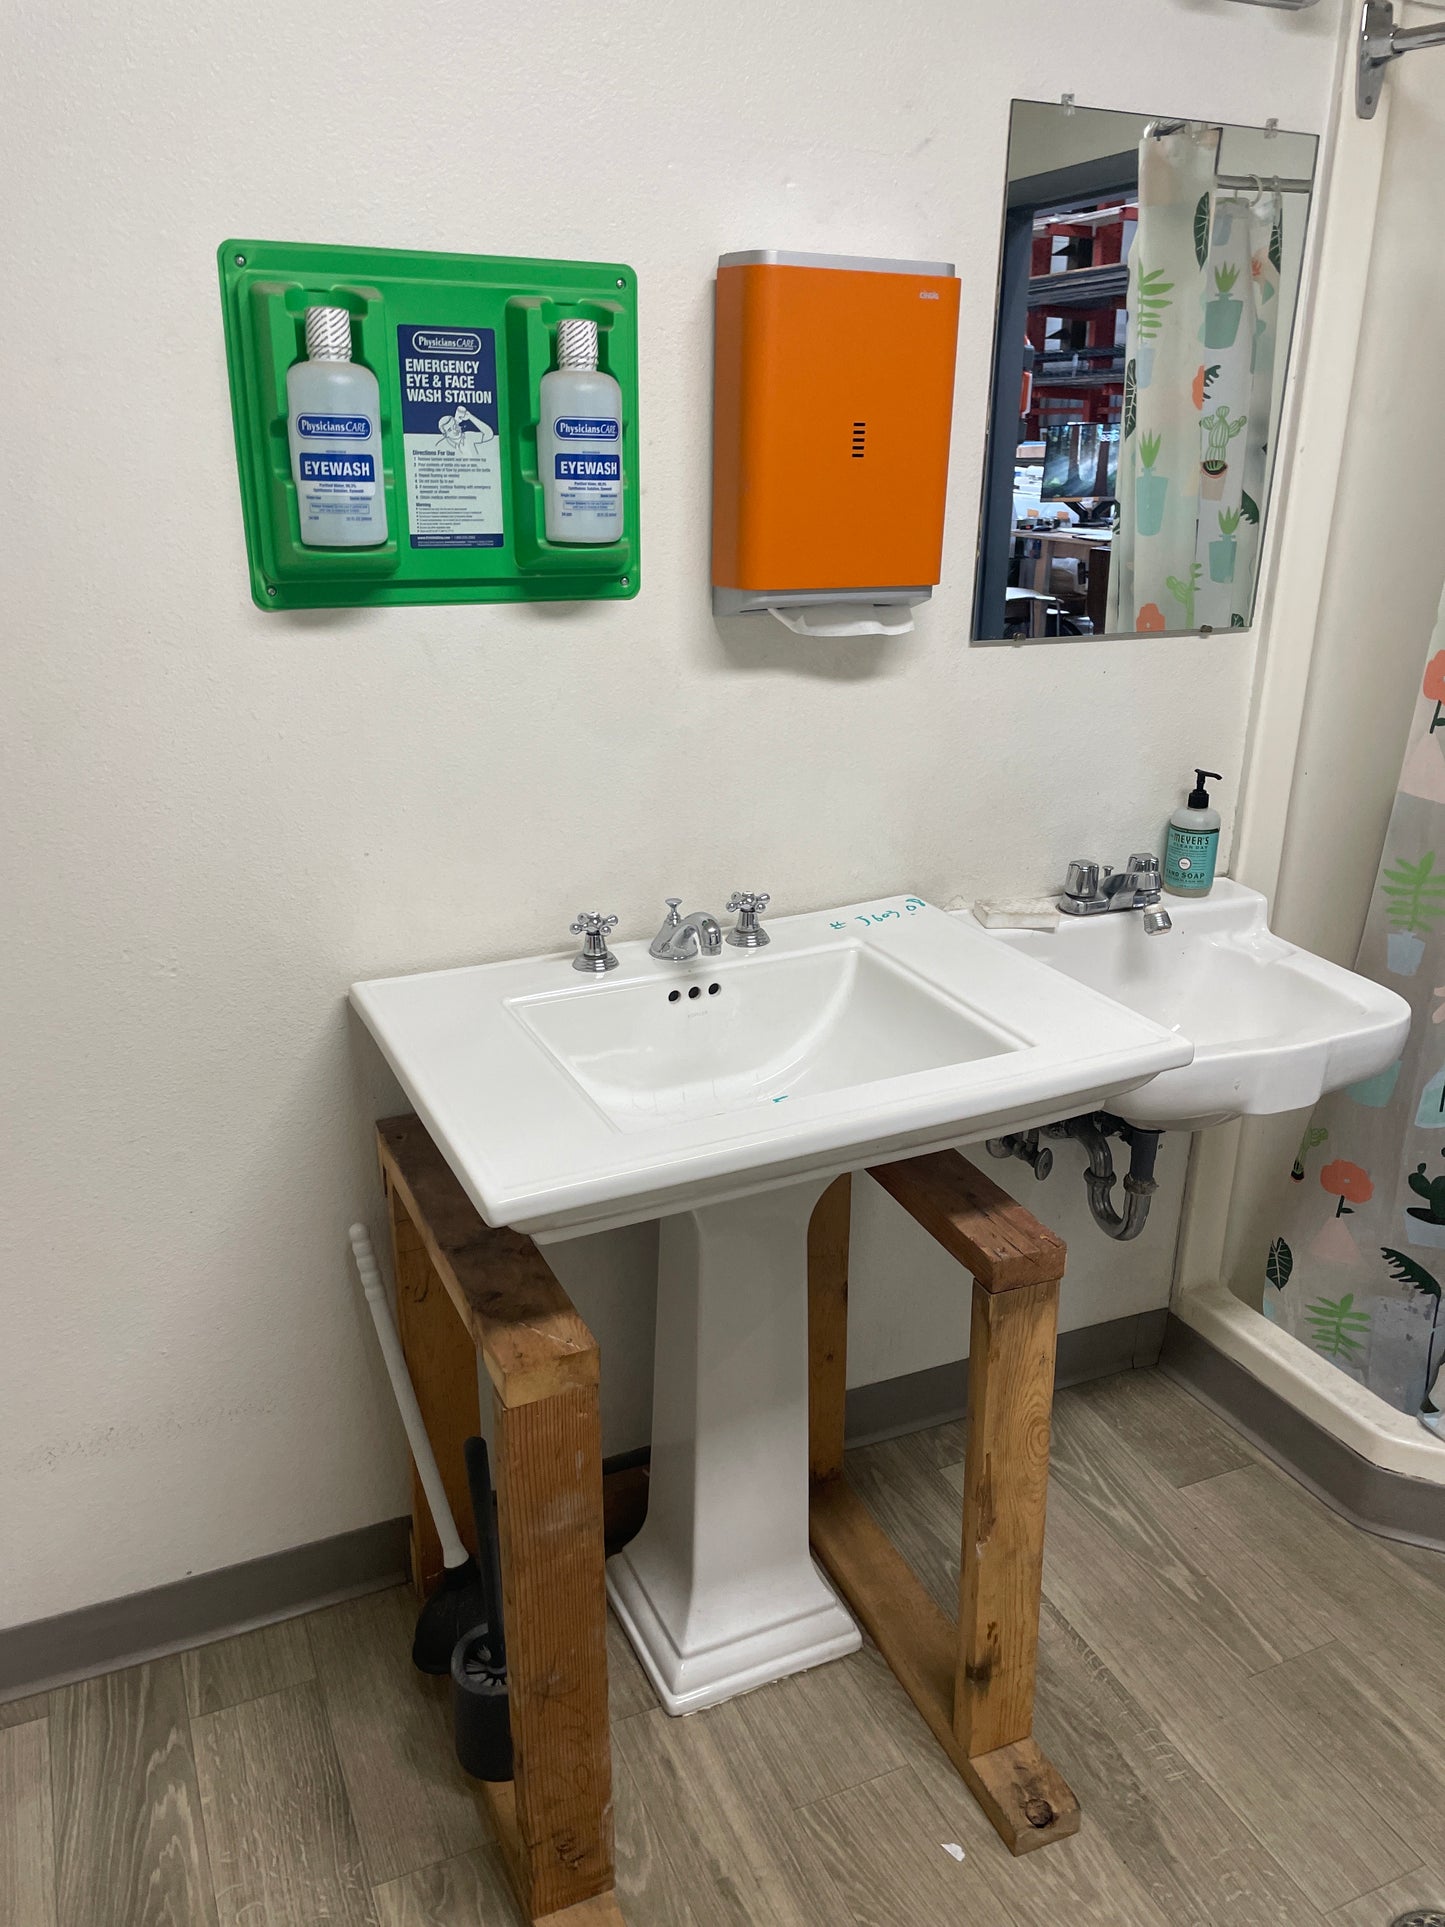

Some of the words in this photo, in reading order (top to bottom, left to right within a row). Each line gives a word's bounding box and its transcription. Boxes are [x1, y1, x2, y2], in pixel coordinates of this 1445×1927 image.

[405, 358, 480, 374] EMERGENCY
[406, 374, 430, 387] EYE
[432, 374, 441, 388] &
[445, 375, 475, 389] FACE
[406, 389, 442, 403] WASH
[444, 390, 492, 404] STATION
[304, 461, 370, 477] EYEWASH
[560, 461, 618, 475] EYEWASH
[1174, 833, 1209, 845] MEYER'S
[1181, 871, 1205, 879] SOAP
